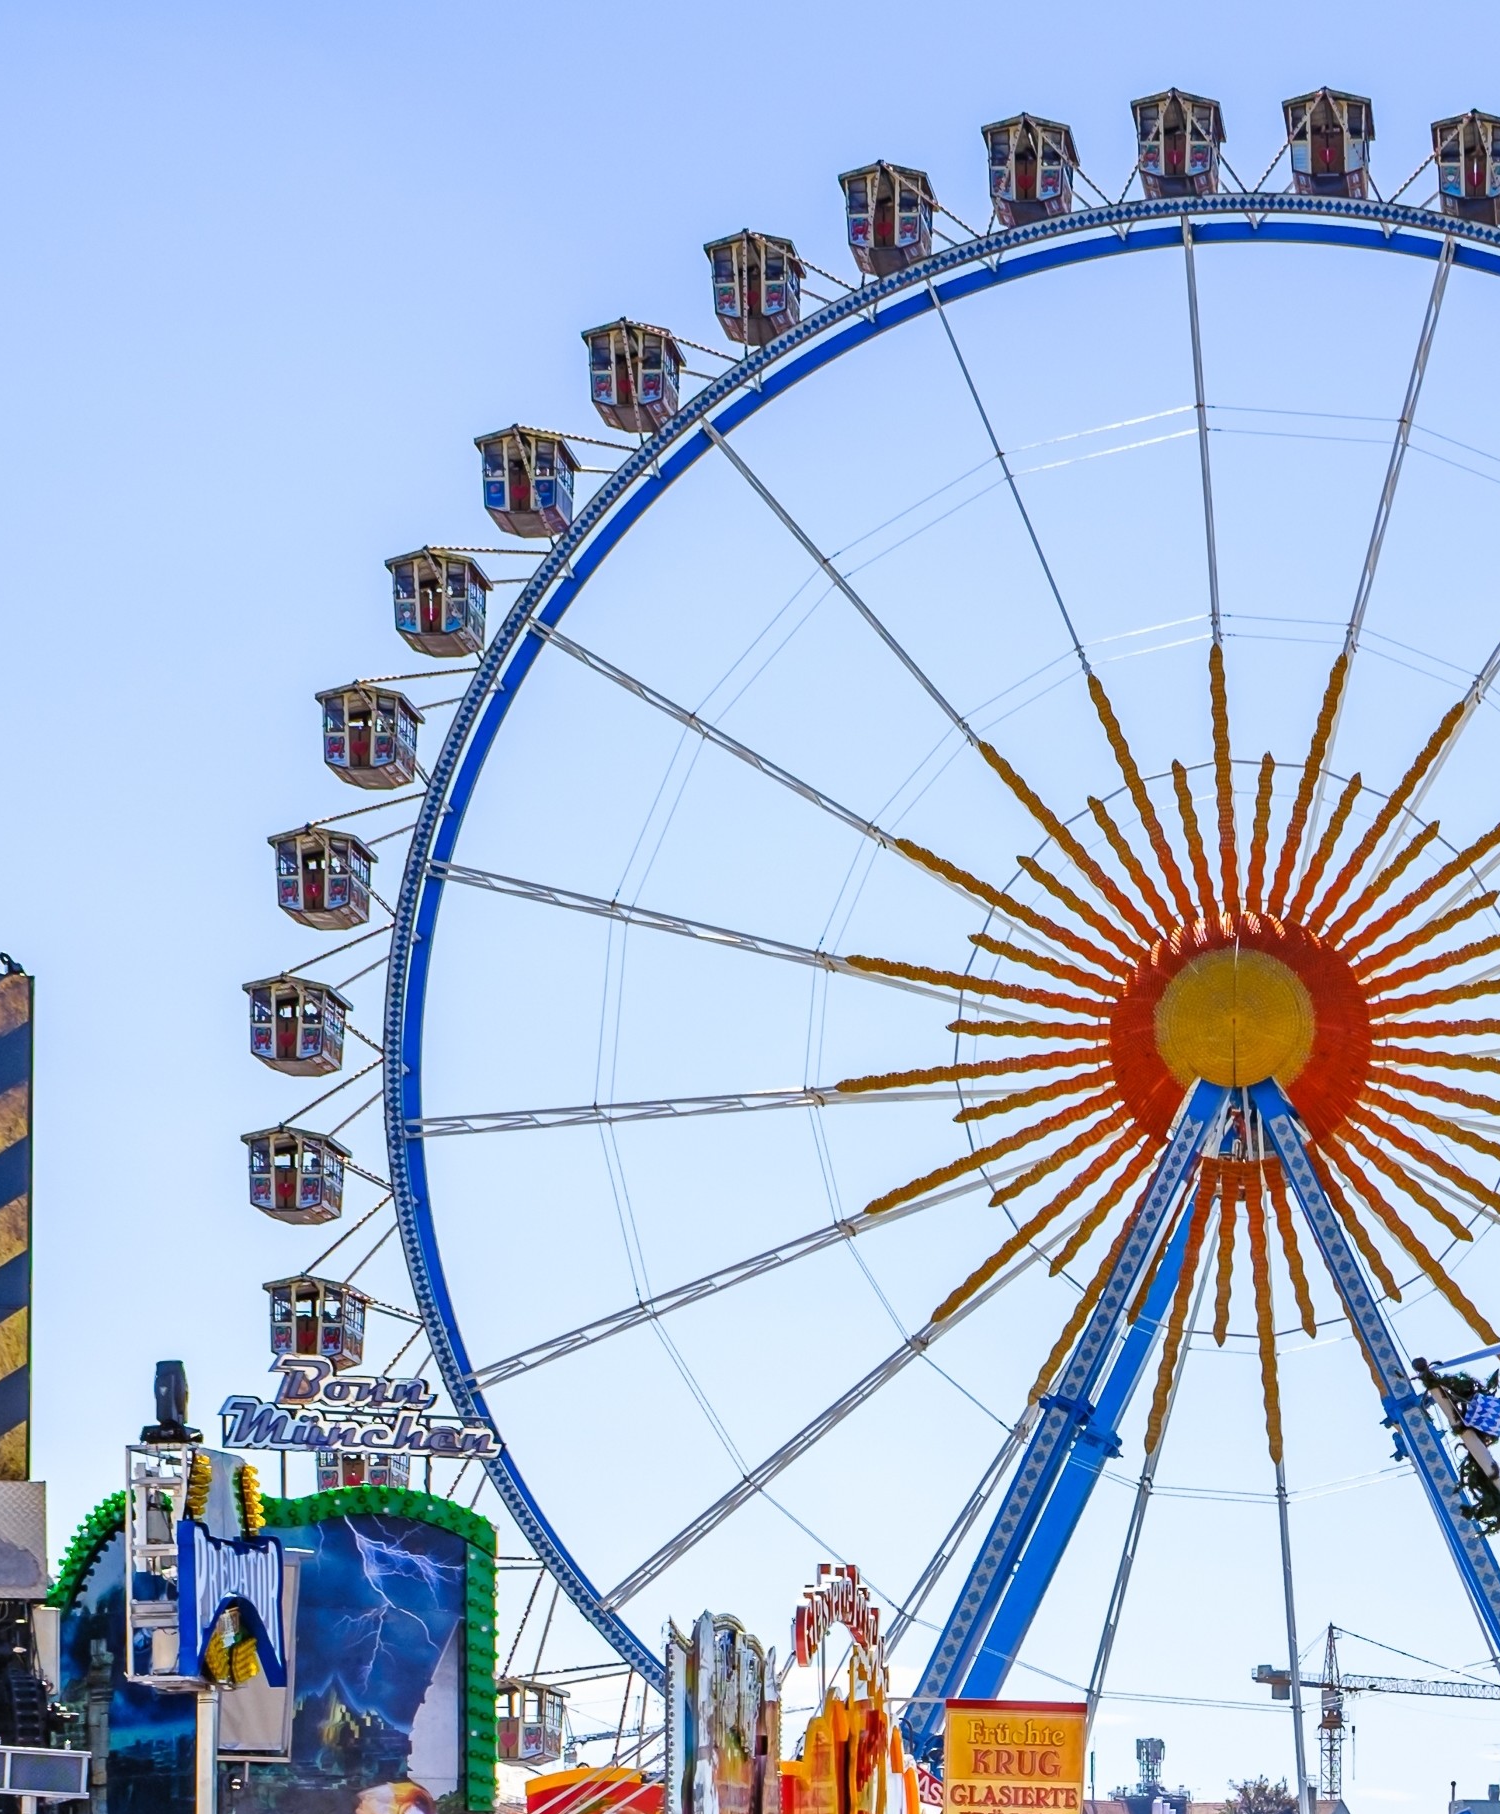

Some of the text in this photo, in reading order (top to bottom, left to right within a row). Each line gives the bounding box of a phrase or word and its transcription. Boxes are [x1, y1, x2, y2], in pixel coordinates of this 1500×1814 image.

[276, 1355, 431, 1406] Bonn
[228, 1400, 496, 1454] München
[193, 1525, 283, 1667] PREDATOR
[968, 1719, 1066, 1746] Früchte
[971, 1748, 1061, 1778] KRUG
[950, 1784, 1079, 1812] GLASIERTE
